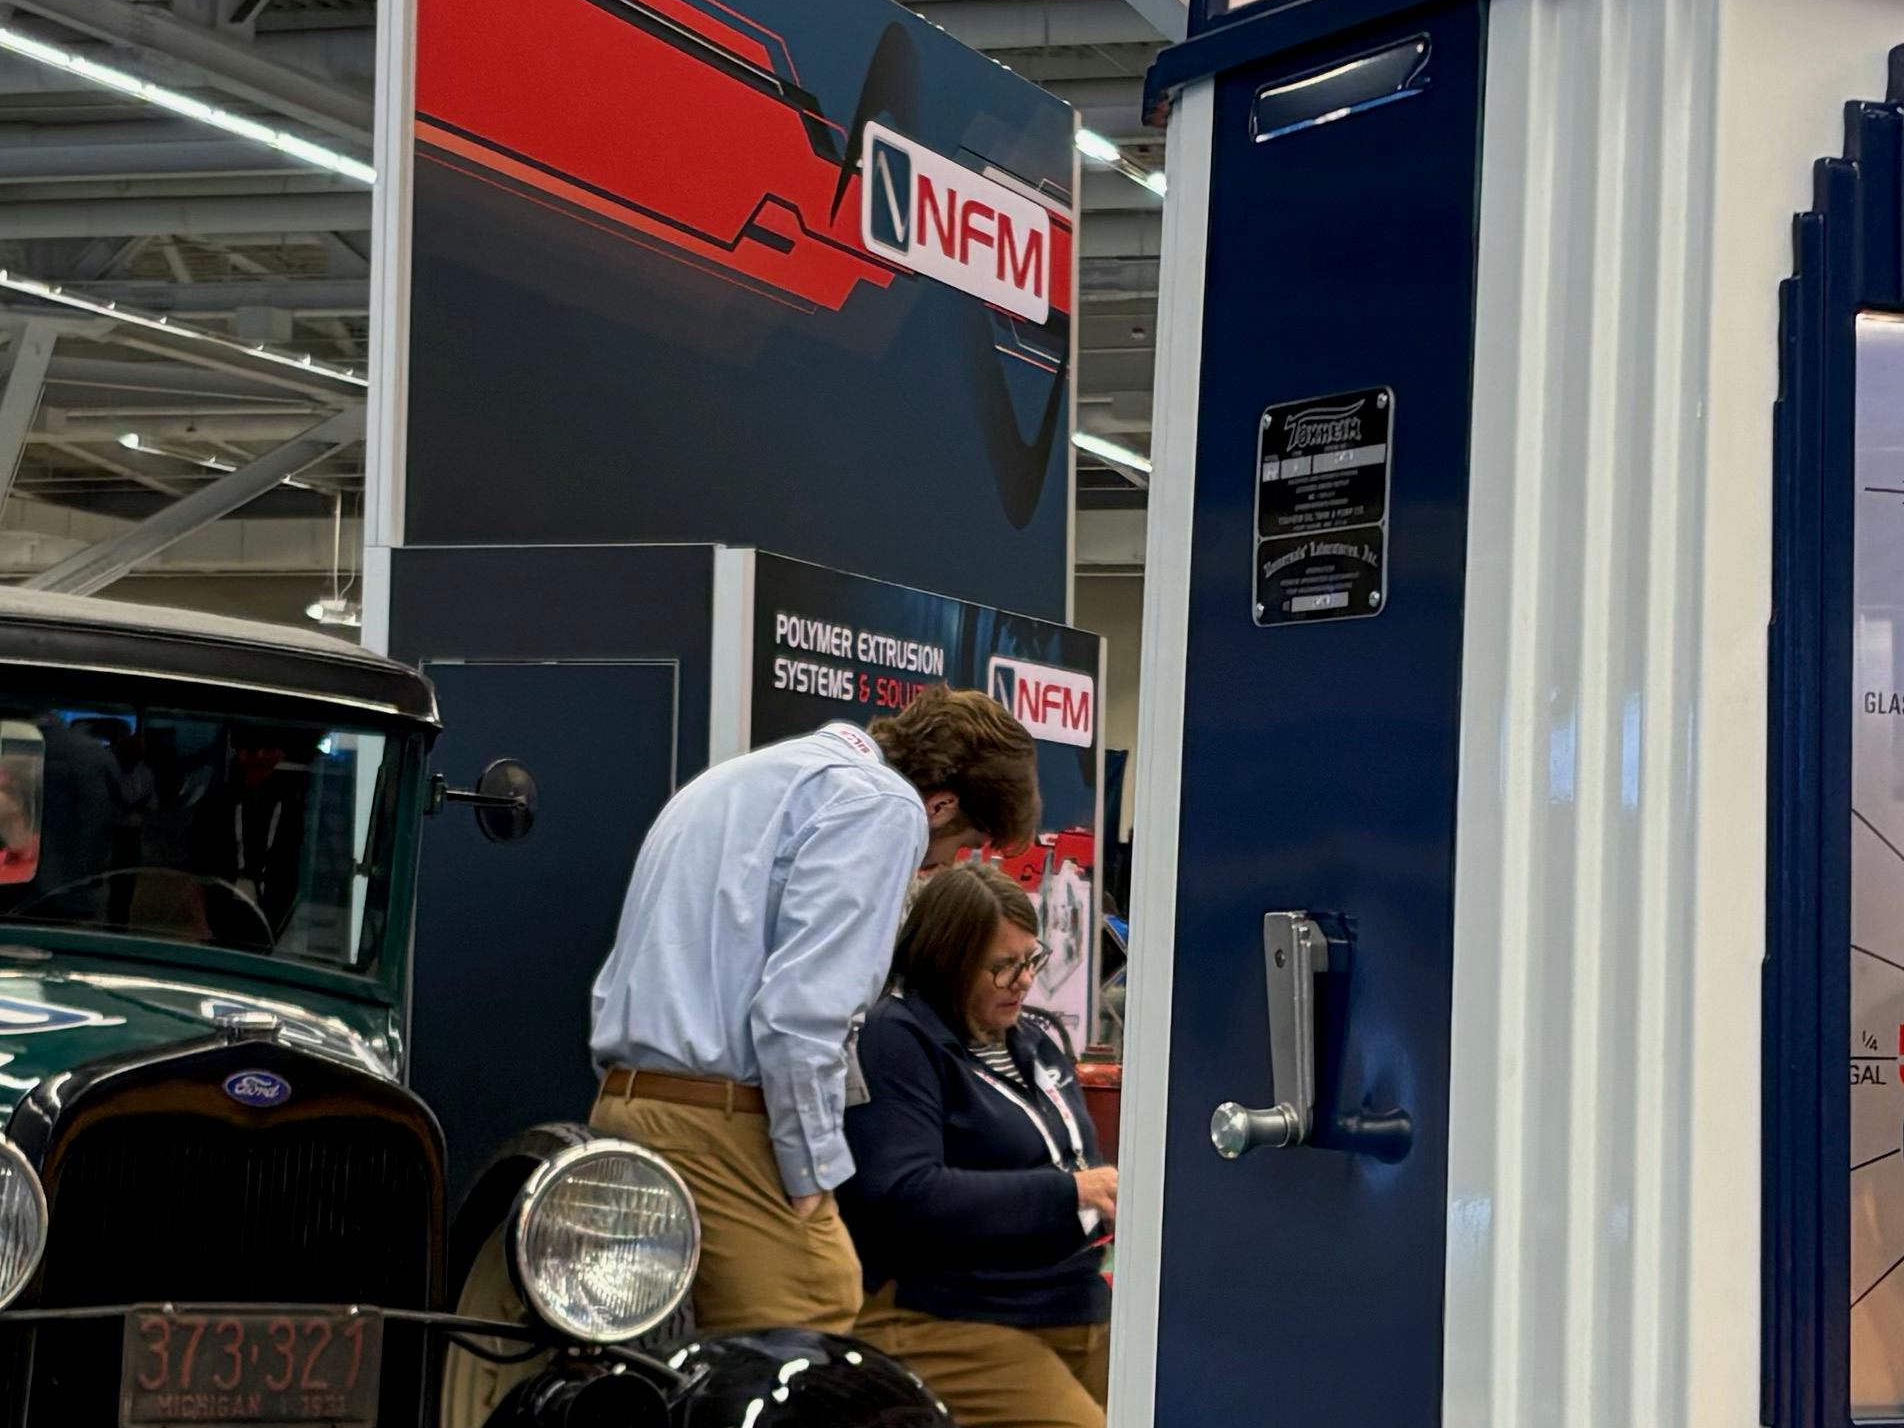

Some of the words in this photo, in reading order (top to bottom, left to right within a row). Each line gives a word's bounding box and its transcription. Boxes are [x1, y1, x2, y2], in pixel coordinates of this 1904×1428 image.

[917, 175, 1046, 299] NFM
[775, 613, 852, 659] POLYMER
[858, 633, 944, 676] EXTRUSION
[774, 658, 854, 700] SYSTEMS
[858, 674, 869, 703] &
[875, 677, 926, 710] SOLU
[1017, 678, 1090, 733] NFM
[234, 1075, 281, 1099] Ford
[1850, 1065, 1887, 1086] GAL
[157, 1394, 262, 1419] MICHIGAN
